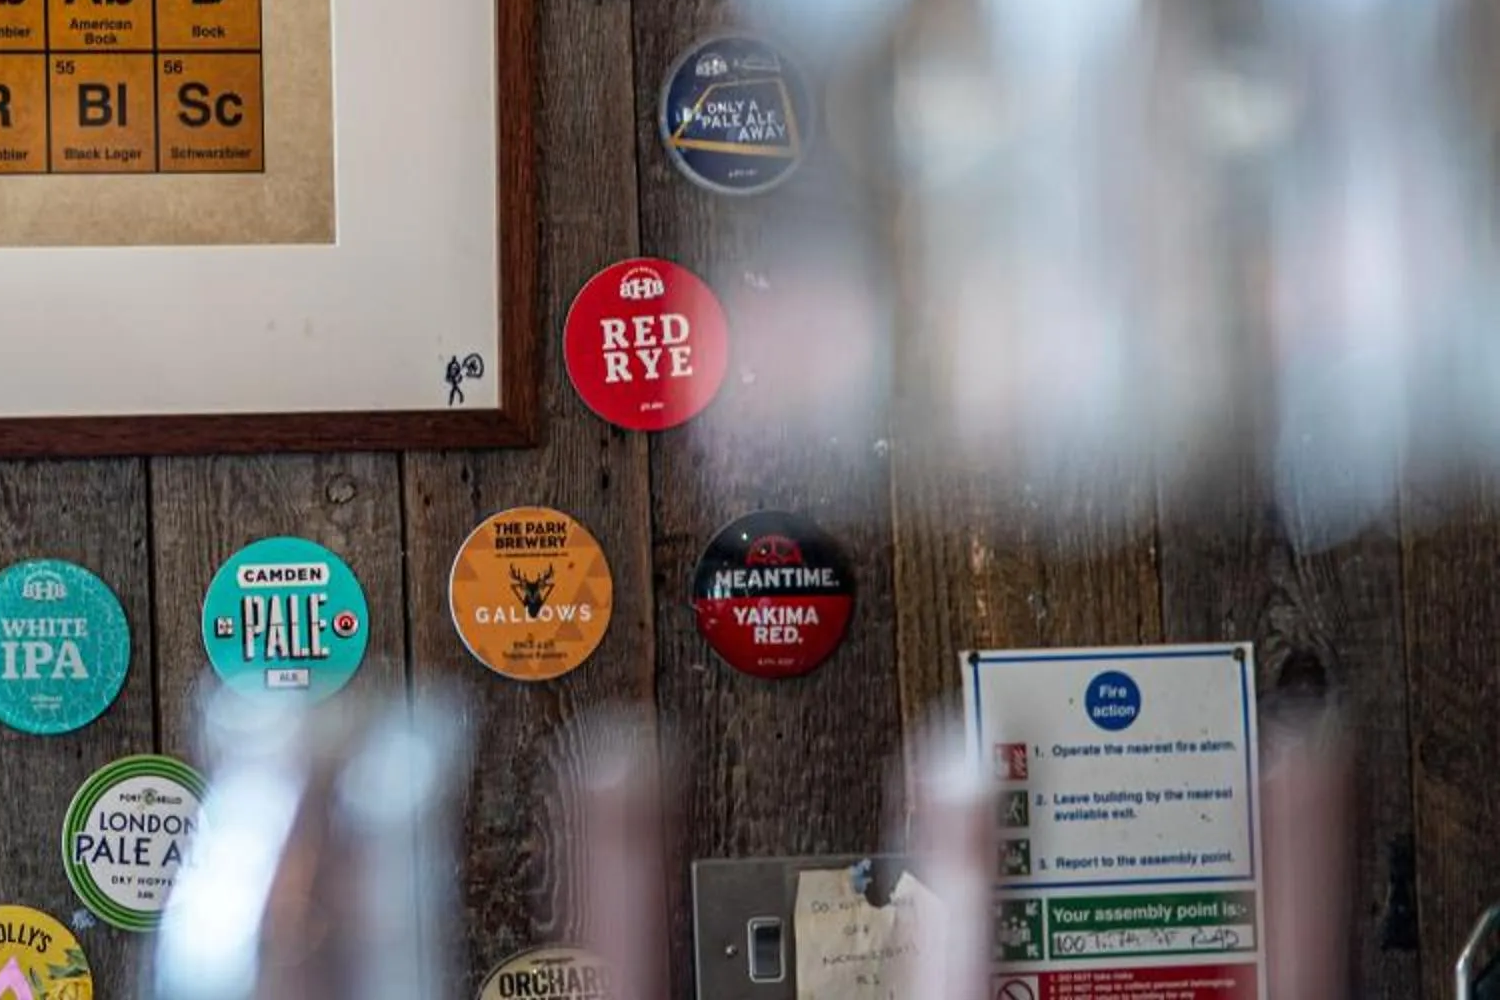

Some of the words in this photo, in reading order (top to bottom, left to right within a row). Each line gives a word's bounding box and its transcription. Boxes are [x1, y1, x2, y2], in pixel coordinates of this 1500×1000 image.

[70, 18, 132, 31] American
[84, 32, 117, 44] Bock
[177, 82, 242, 128] Sc
[707, 100, 745, 115] ONLY
[738, 124, 786, 142] AWAY
[600, 313, 690, 350] RED
[603, 346, 693, 383] RYE
[494, 522, 522, 535] THE
[525, 521, 568, 535] PARK
[495, 536, 568, 549] BREWERY
[243, 567, 322, 582] CAMDEN
[715, 567, 840, 588] MEANTIME.
[475, 604, 592, 624] GALLOWS
[733, 605, 820, 626] YAKIMA
[0, 617, 88, 637] WHITE
[243, 593, 330, 659] PALE
[754, 625, 804, 645] RED.
[0, 639, 89, 680] IPA
[1099, 685, 1128, 698] Fire
[1093, 703, 1135, 718] action
[1052, 743, 1100, 759] Operate
[1104, 743, 1124, 755] the
[1127, 741, 1173, 754] nearest
[1175, 740, 1197, 752] fire
[1053, 793, 1090, 805] Leave
[1093, 790, 1142, 806] building
[100, 812, 197, 835] LONDON
[76, 834, 151, 866] PALE
[1055, 856, 1099, 870] Report
[1053, 907, 1091, 924] Your
[1094, 904, 1172, 922] assembly
[1177, 902, 1219, 921] point
